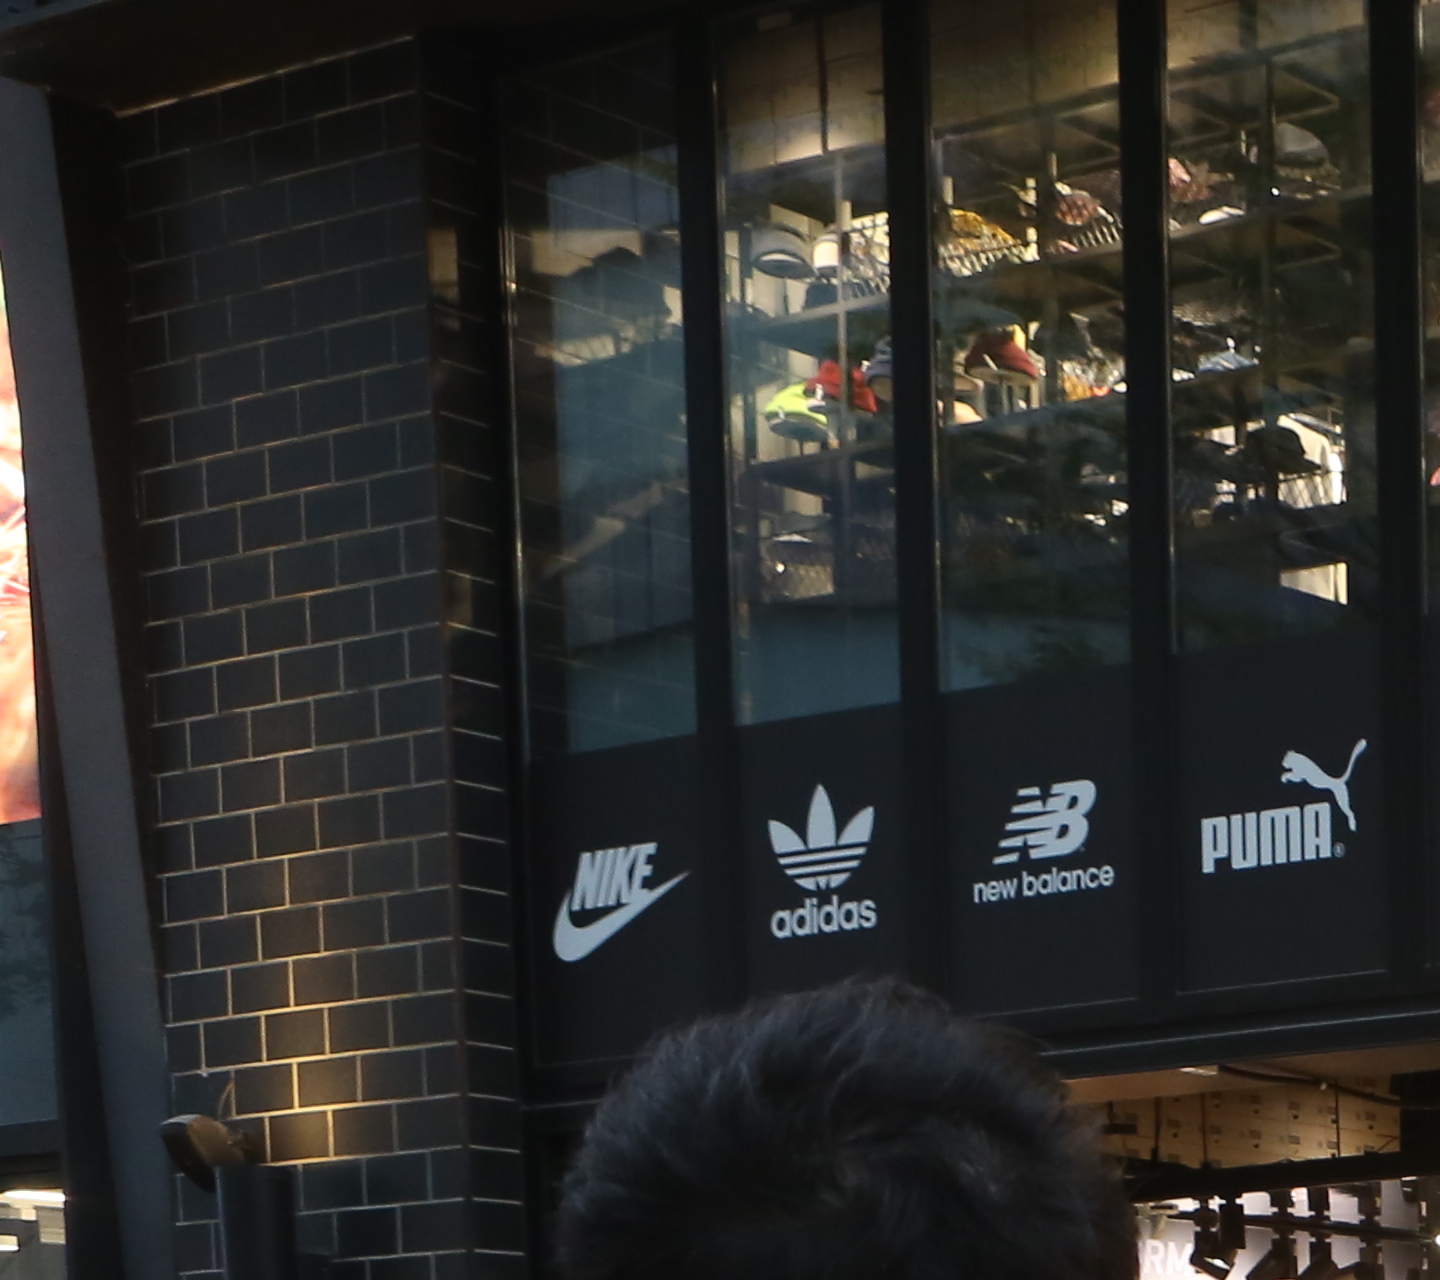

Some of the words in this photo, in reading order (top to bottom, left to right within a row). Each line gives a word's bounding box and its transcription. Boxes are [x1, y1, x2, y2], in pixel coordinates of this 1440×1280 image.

[1201, 803, 1331, 873] PUMA
[572, 842, 657, 912] NIKE
[973, 874, 1018, 904] new
[1023, 864, 1115, 898] balance
[770, 898, 877, 939] adidas
